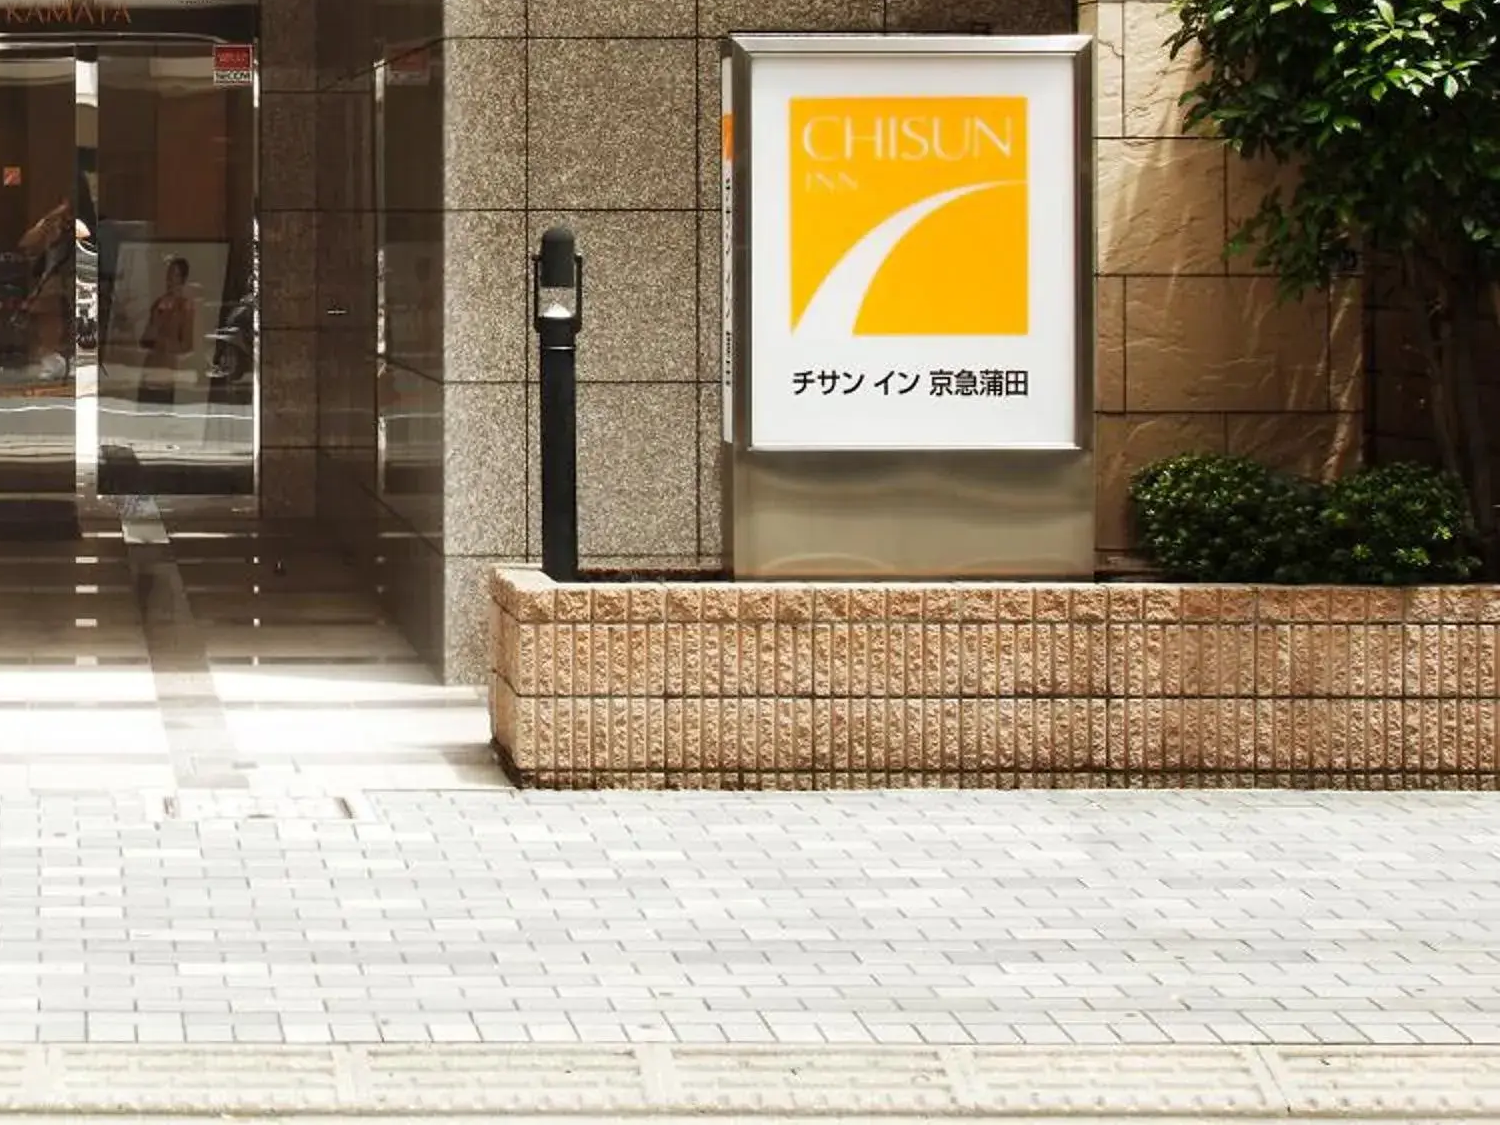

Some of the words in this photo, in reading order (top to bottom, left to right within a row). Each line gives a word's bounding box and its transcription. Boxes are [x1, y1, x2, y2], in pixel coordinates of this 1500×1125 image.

[6, 1, 132, 24] KAMATA
[801, 114, 1013, 163] CHISUN
[804, 170, 858, 193] INN
[791, 369, 866, 396] チサン
[873, 369, 920, 396] イン
[928, 368, 1030, 397] 京急蒲田
